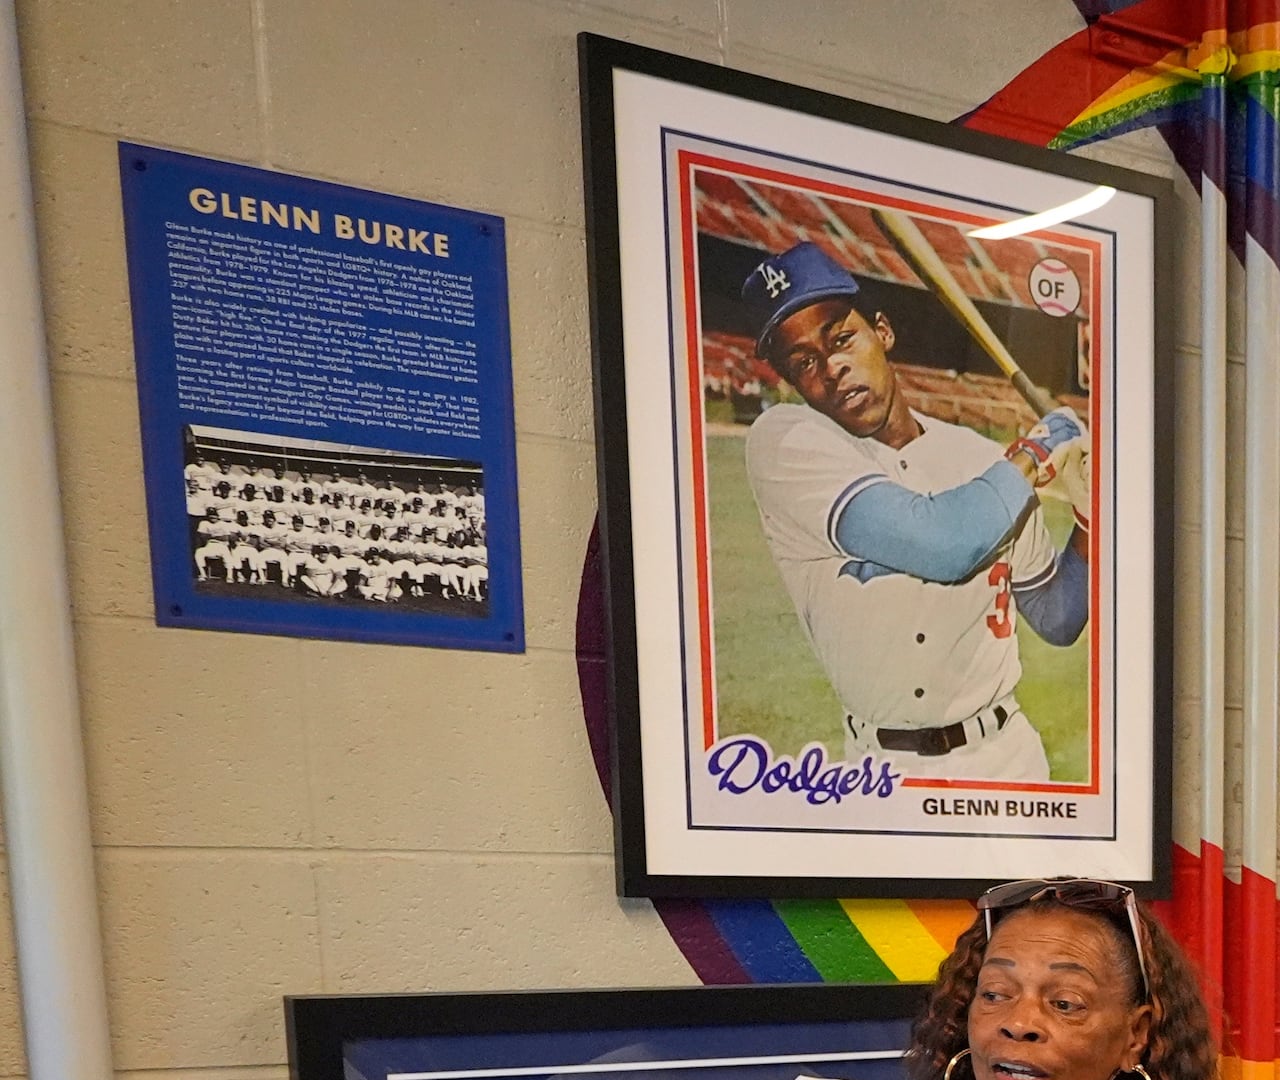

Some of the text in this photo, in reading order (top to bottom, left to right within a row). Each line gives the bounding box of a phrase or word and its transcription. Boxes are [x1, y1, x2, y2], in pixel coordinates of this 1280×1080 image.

[188, 187, 450, 258] GLENN BURKE
[165, 220, 189, 232] Glenn
[190, 225, 212, 236] Burke
[213, 229, 235, 240] made
[379, 259, 392, 268] first
[393, 262, 417, 274] openly
[418, 268, 431, 276] gay
[459, 274, 472, 282] and
[208, 247, 230, 258] Burke
[231, 251, 258, 264] played
[258, 256, 269, 265] for
[270, 258, 282, 267] the
[284, 260, 295, 269] Los
[358, 273, 375, 283] from
[418, 284, 432, 293] and
[432, 286, 443, 295] the
[249, 245, 271, 257] figure
[282, 251, 299, 260] both
[302, 254, 324, 266] sports
[326, 258, 340, 268] and
[408, 273, 430, 283] native
[201, 274, 226, 285] before
[292, 290, 314, 301] Major
[315, 293, 341, 306] League
[342, 300, 367, 310] games.
[368, 302, 392, 314] During
[392, 306, 402, 315] his
[404, 308, 418, 317] MLB
[453, 316, 475, 327] batted
[202, 255, 220, 266] from
[272, 268, 298, 279] Known
[300, 272, 311, 281] for
[314, 275, 324, 283] his
[356, 282, 380, 294] speed,
[420, 293, 434, 302] and
[215, 267, 237, 278] Burke
[332, 287, 347, 296] who
[350, 290, 360, 298] set
[362, 292, 383, 302] stolen
[385, 296, 402, 306] base
[440, 305, 452, 314] the
[454, 308, 474, 318] Minor
[756, 261, 791, 298] LA
[1037, 278, 1065, 299] OF
[707, 739, 900, 805] Dodgers
[922, 798, 1078, 819] GLENN BURKE
